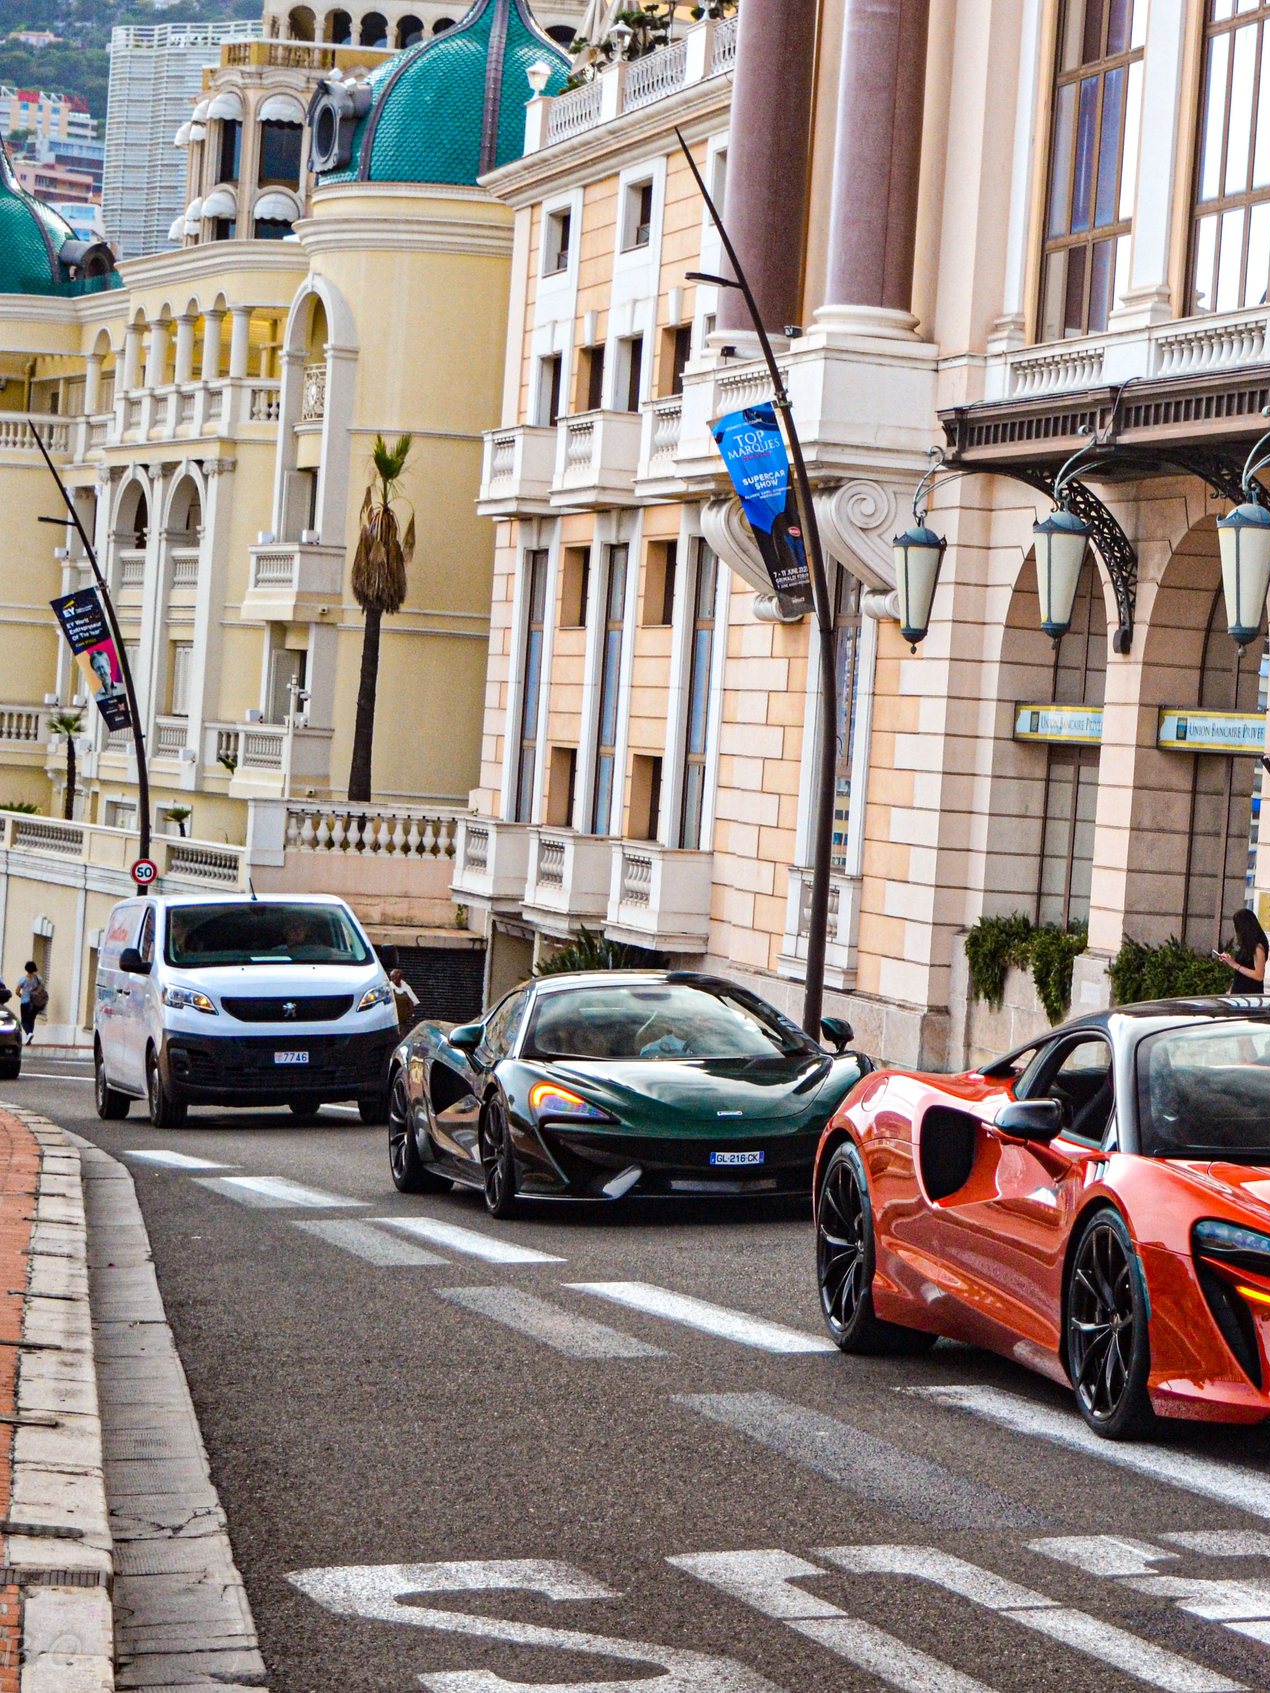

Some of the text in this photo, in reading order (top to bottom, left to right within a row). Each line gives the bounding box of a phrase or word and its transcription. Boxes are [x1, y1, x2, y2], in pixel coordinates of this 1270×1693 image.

[733, 429, 765, 448] TOP
[727, 437, 781, 460] MARQUES
[742, 469, 786, 486] SUPERCAR
[754, 478, 778, 490] SHOW
[63, 606, 75, 618] EY
[1189, 721, 1211, 737] UNION
[1211, 722, 1241, 739] BANCAIRE
[136, 866, 153, 878] 50
[283, 1052, 308, 1063] 7746
